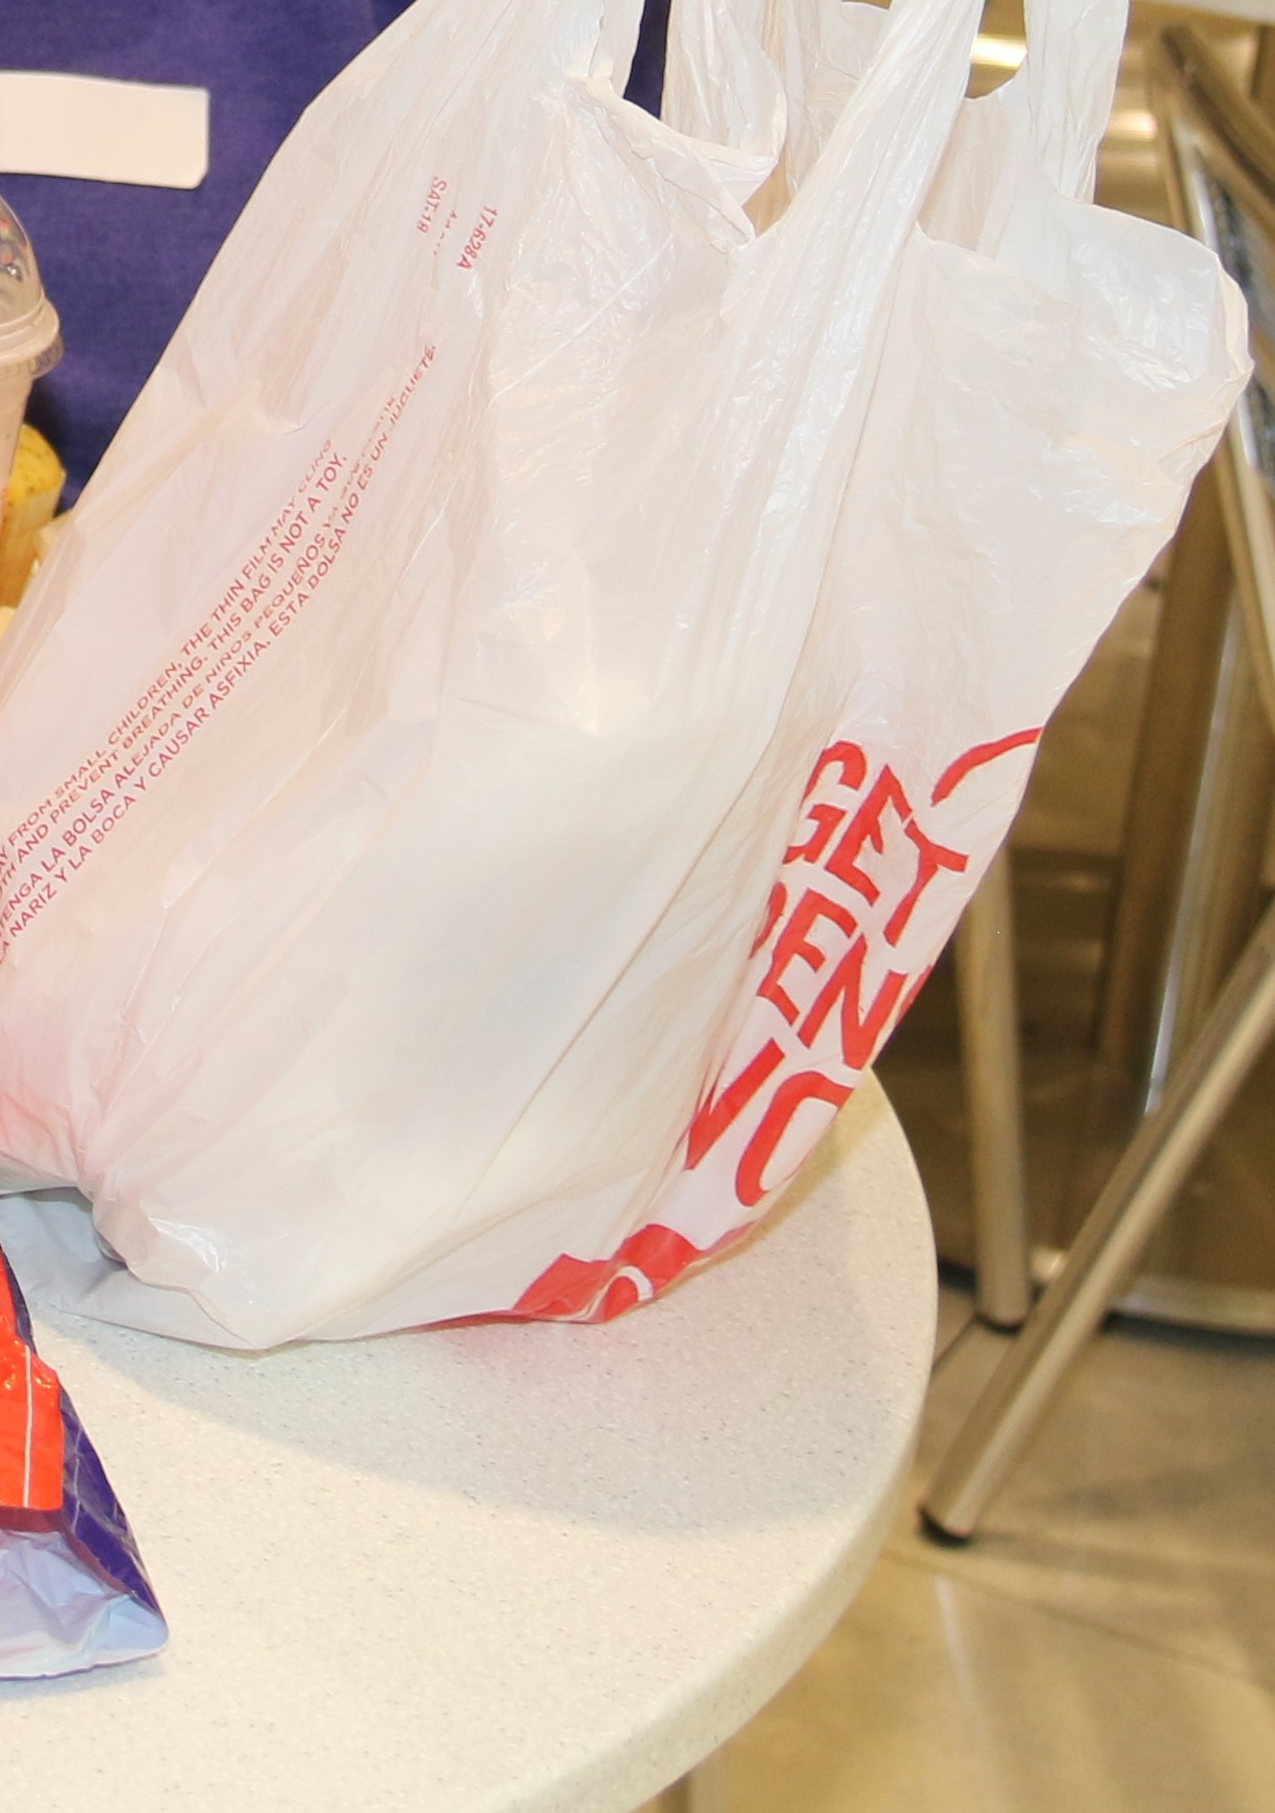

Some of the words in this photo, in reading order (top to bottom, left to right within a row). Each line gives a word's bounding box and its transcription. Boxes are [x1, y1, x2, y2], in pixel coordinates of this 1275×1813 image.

[7, 798, 53, 848] FROM
[53, 748, 107, 799] SMALL
[107, 661, 184, 746] CHILDREN,
[180, 622, 213, 657] THE
[210, 578, 246, 622] THIN
[241, 536, 273, 580] FILM
[9, 881, 59, 938] NARIZ
[54, 866, 69, 884] Y
[67, 844, 94, 871] LA
[90, 793, 138, 845] BOCA
[133, 775, 149, 793] Y
[147, 706, 211, 779] CAUSAR
[208, 639, 273, 710] ASFIXIA.
[267, 591, 311, 638] ESTA
[340, 492, 361, 525] NO
[369, 432, 389, 462] UN
[16, 823, 50, 864] AND
[49, 748, 120, 825] PREVENT
[122, 655, 209, 751] BREATHING.
[207, 612, 243, 652] THIS
[239, 573, 273, 614] BAG
[266, 552, 285, 574] IS
[278, 510, 309, 555] NOT
[307, 495, 322, 514] A
[315, 452, 348, 493] TOY.
[40, 846, 67, 873] LA
[61, 787, 116, 848] BOLSA
[113, 711, 183, 790] ALEJADA
[181, 682, 205, 710] DE
